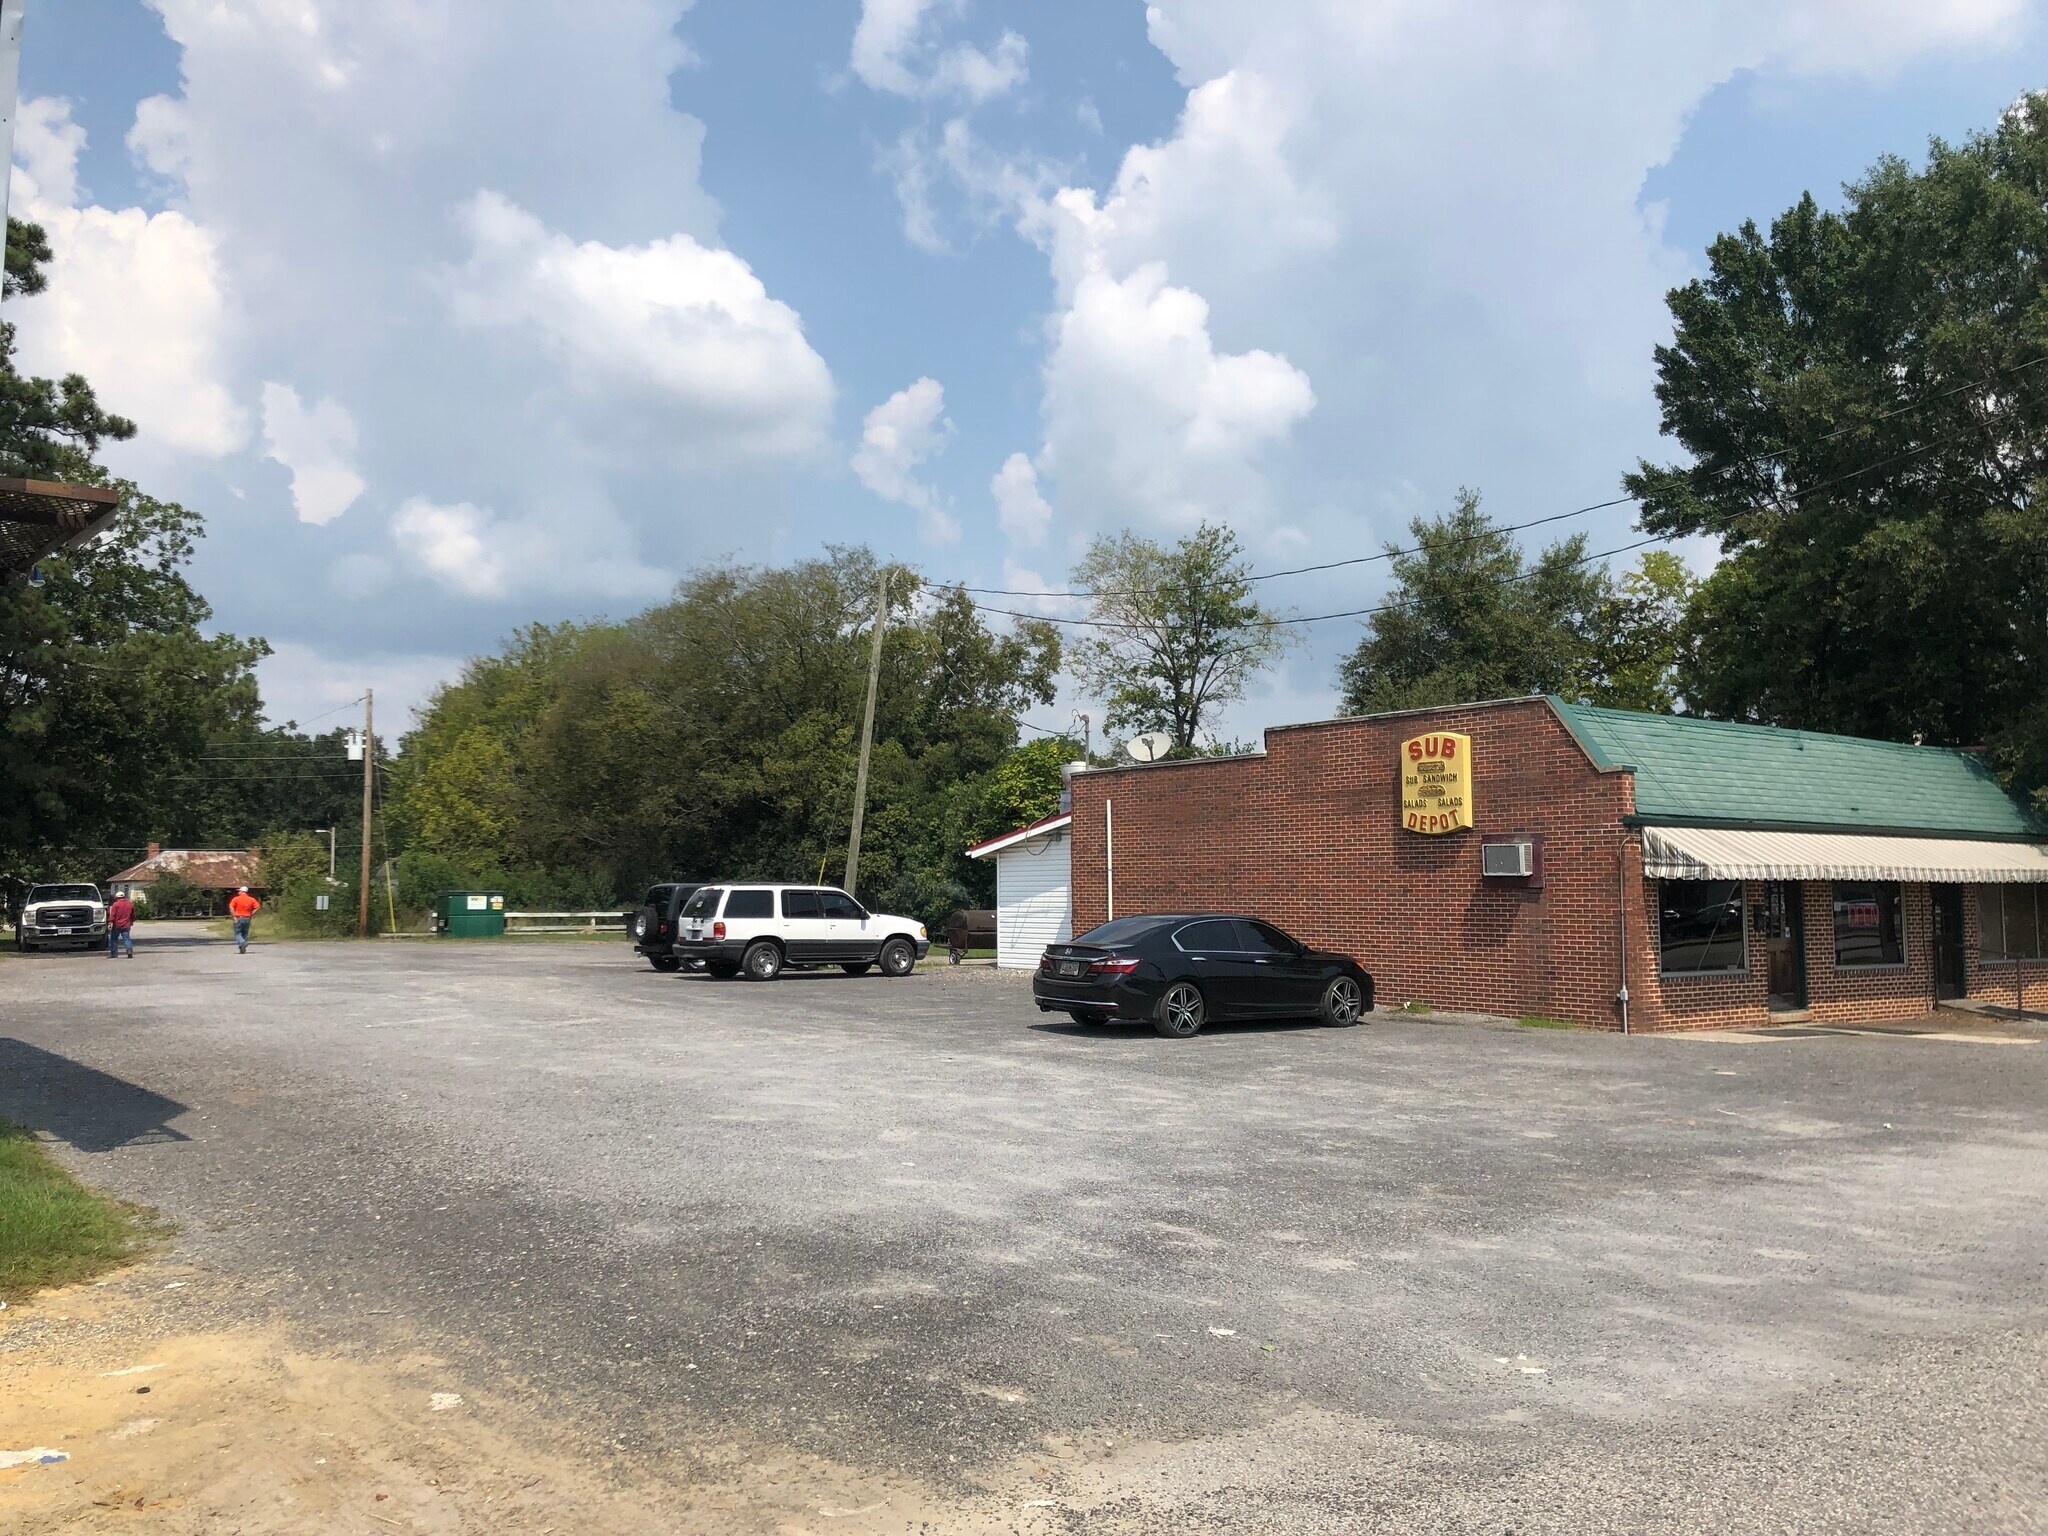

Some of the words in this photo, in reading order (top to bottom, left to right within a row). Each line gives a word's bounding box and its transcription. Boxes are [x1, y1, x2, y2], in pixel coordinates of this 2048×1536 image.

[1408, 737, 1456, 760] SUB
[1405, 776, 1418, 785] SUB
[1423, 773, 1458, 783] SANDWICH
[1404, 799, 1427, 808] SALADS
[1437, 797, 1463, 807] SALADS
[1408, 809, 1459, 832] DEPOT
